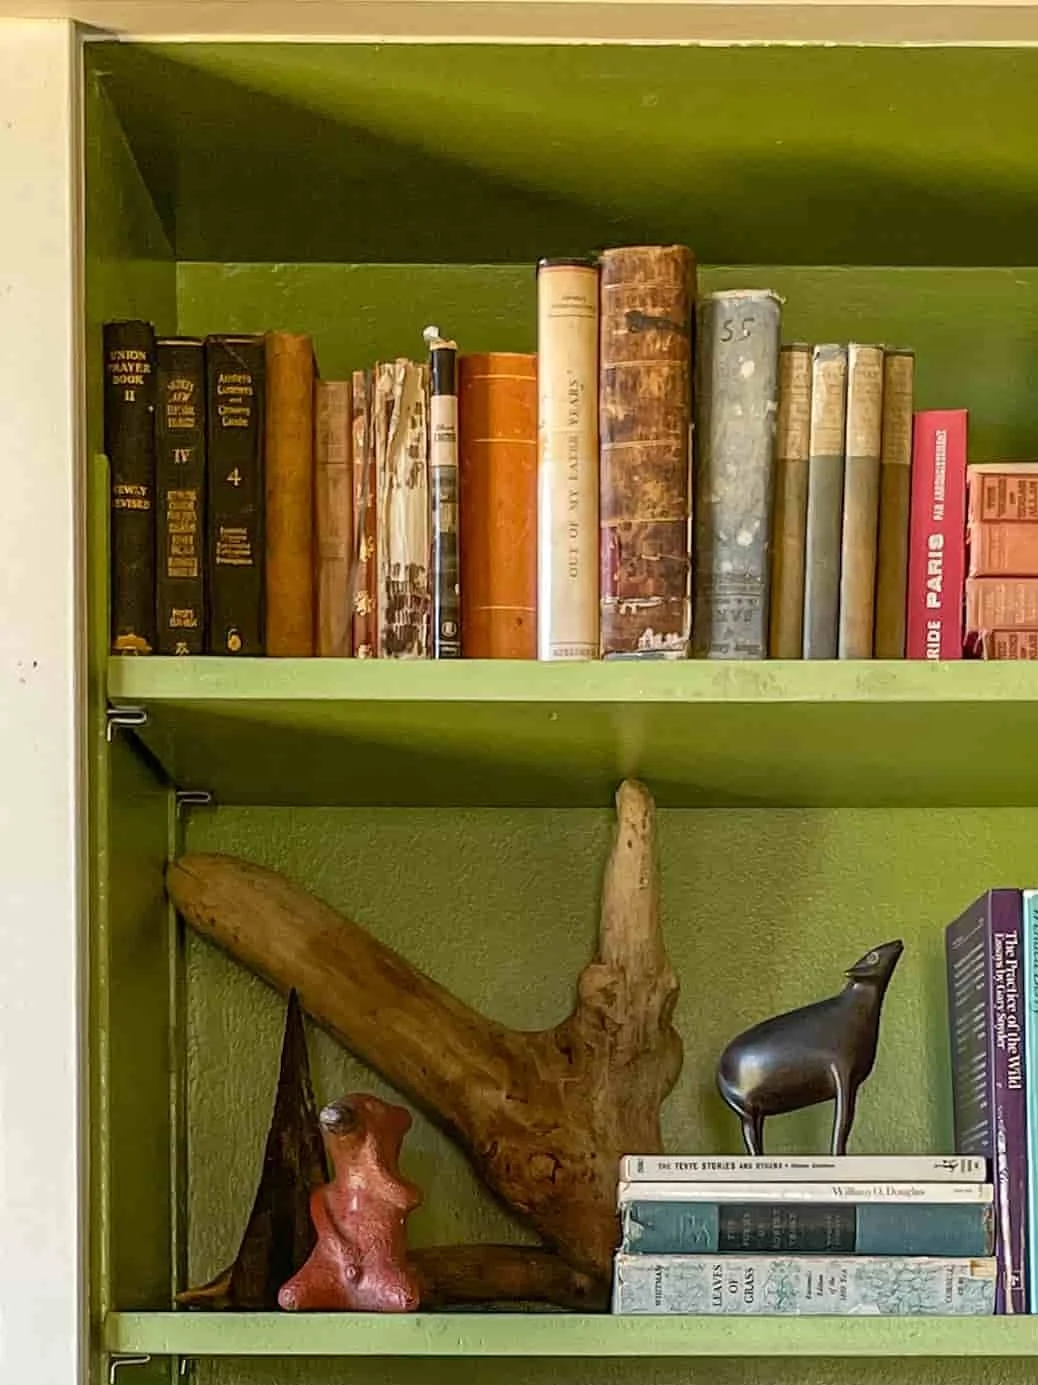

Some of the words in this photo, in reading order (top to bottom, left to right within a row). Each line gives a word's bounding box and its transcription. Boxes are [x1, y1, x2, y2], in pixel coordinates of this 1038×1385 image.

[567, 379, 578, 426] YEARS
[225, 467, 243, 488] 4
[567, 489, 578, 511] MY
[567, 521, 579, 539] OF
[567, 551, 579, 578] OUT
[926, 533, 944, 609] PARIS
[1005, 931, 1018, 957] The
[1006, 959, 1020, 1013] Practice
[1007, 1015, 1019, 1031] of
[1007, 1032, 1020, 1051] the
[1007, 1051, 1021, 1089] Wild
[712, 1264, 723, 1307] LEAVES
[728, 1279, 739, 1294] OF
[744, 1267, 755, 1303] GRASS
